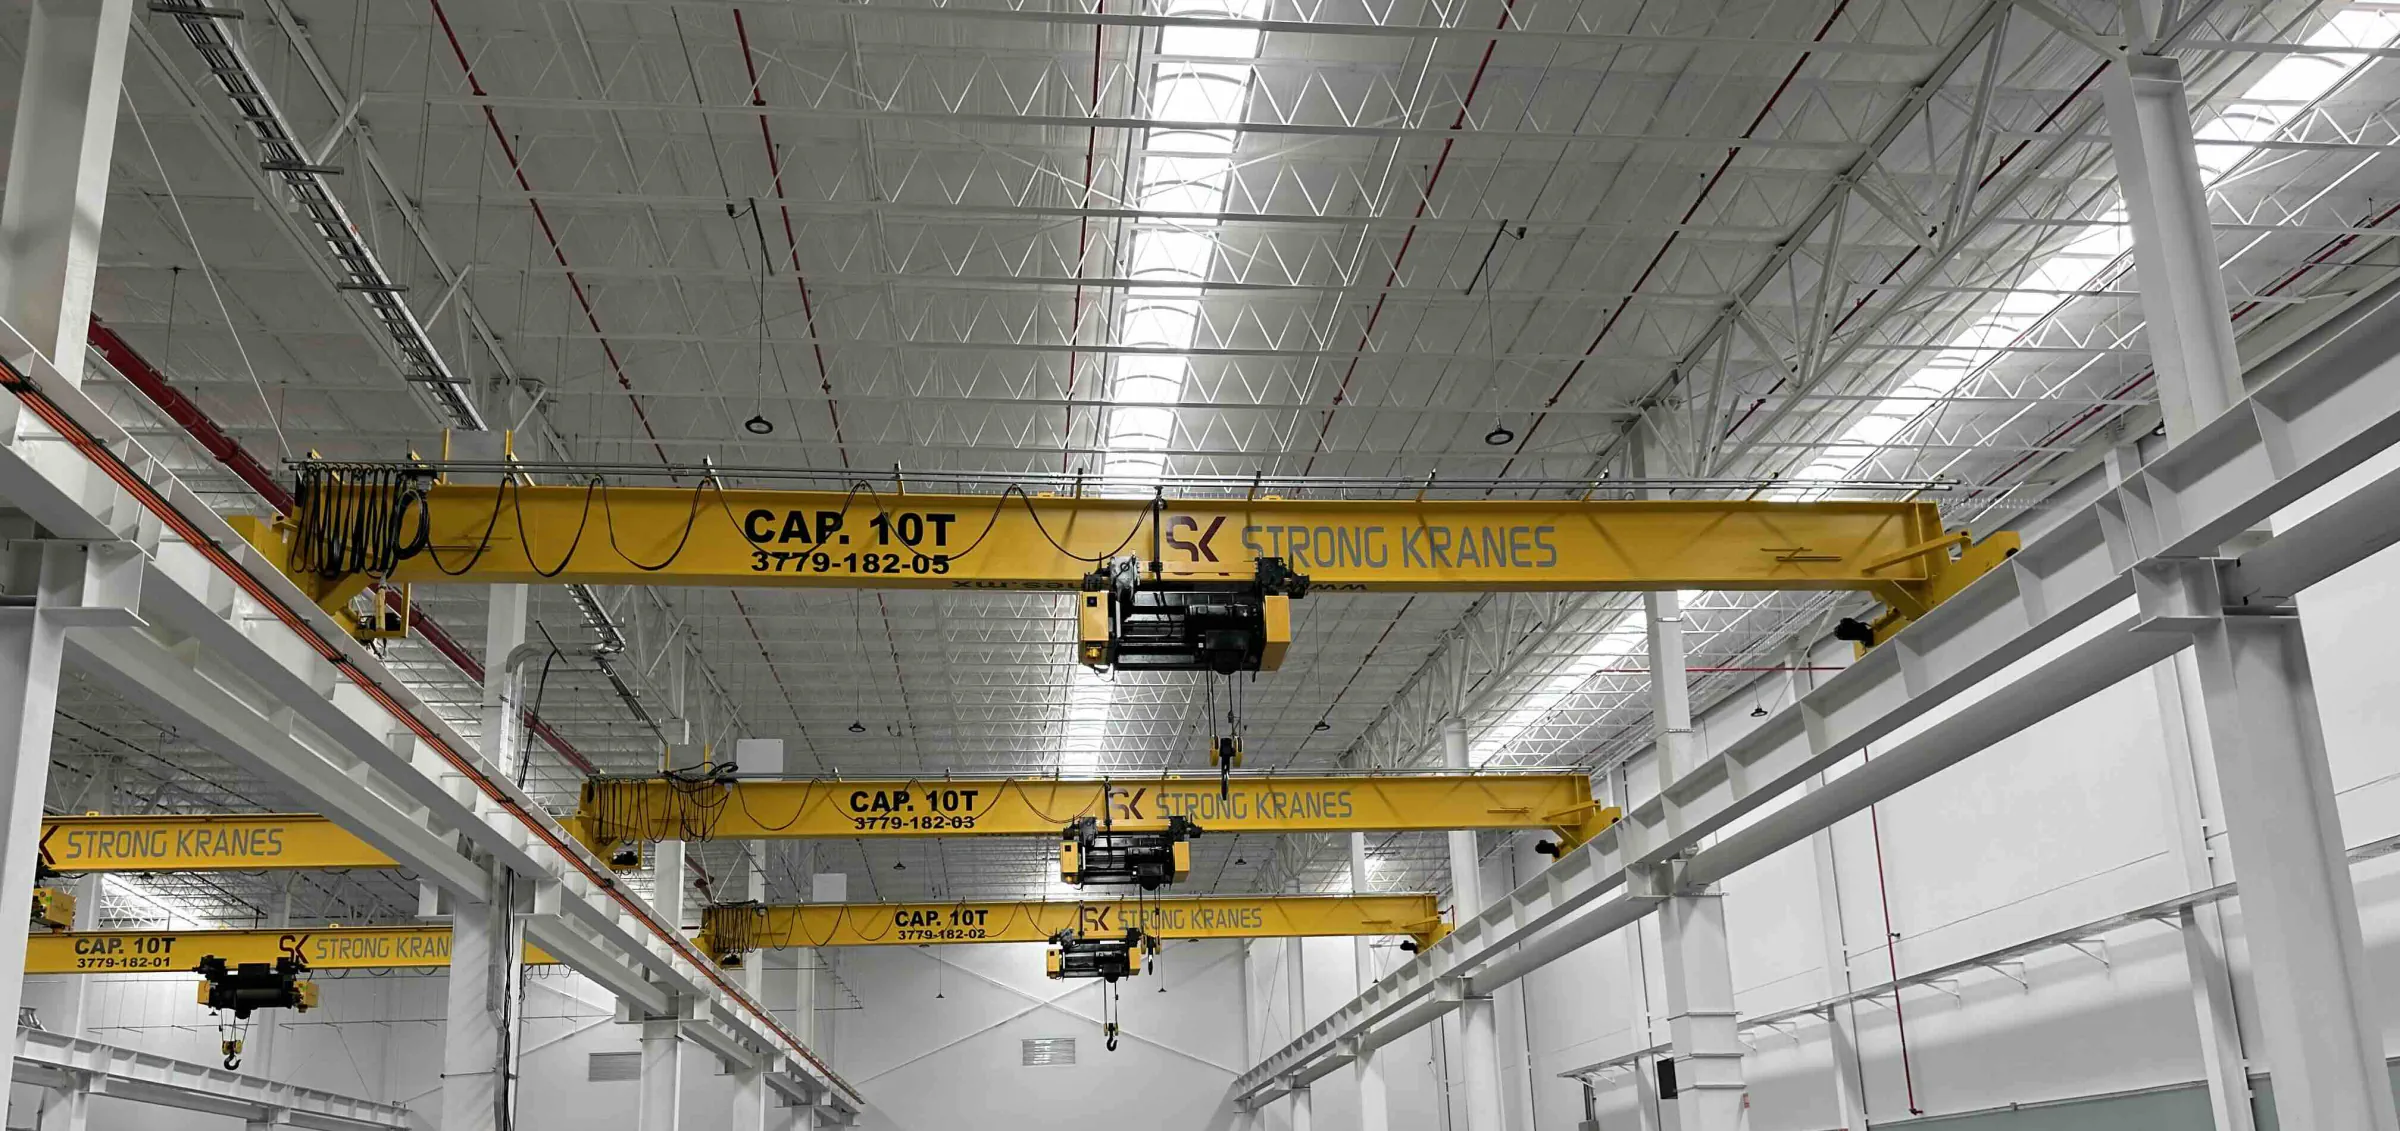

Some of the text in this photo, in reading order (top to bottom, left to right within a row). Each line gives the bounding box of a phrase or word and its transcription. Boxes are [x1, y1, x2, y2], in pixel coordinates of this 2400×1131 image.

[744, 509, 956, 547] CAP. 10T
[1241, 525, 1388, 568] STRONG
[1402, 525, 1558, 568] KRANES
[751, 551, 950, 575] 3779-182-05
[850, 790, 979, 813] CAP. 10T
[1156, 792, 1248, 820] STRONG
[1256, 790, 1353, 819] KRANES
[854, 816, 976, 830] 3779-182-03
[39, 824, 284, 865] K STRONG KRANES
[894, 910, 989, 927] CAP. 10T
[1118, 910, 1185, 930] STRONG
[1191, 907, 1263, 929] KRANES
[74, 937, 177, 955] CAP. 10T
[897, 929, 986, 940] 3779-182-02
[279, 934, 452, 964] SK STRONG KRAN
[77, 956, 171, 968] 3779-182-01
